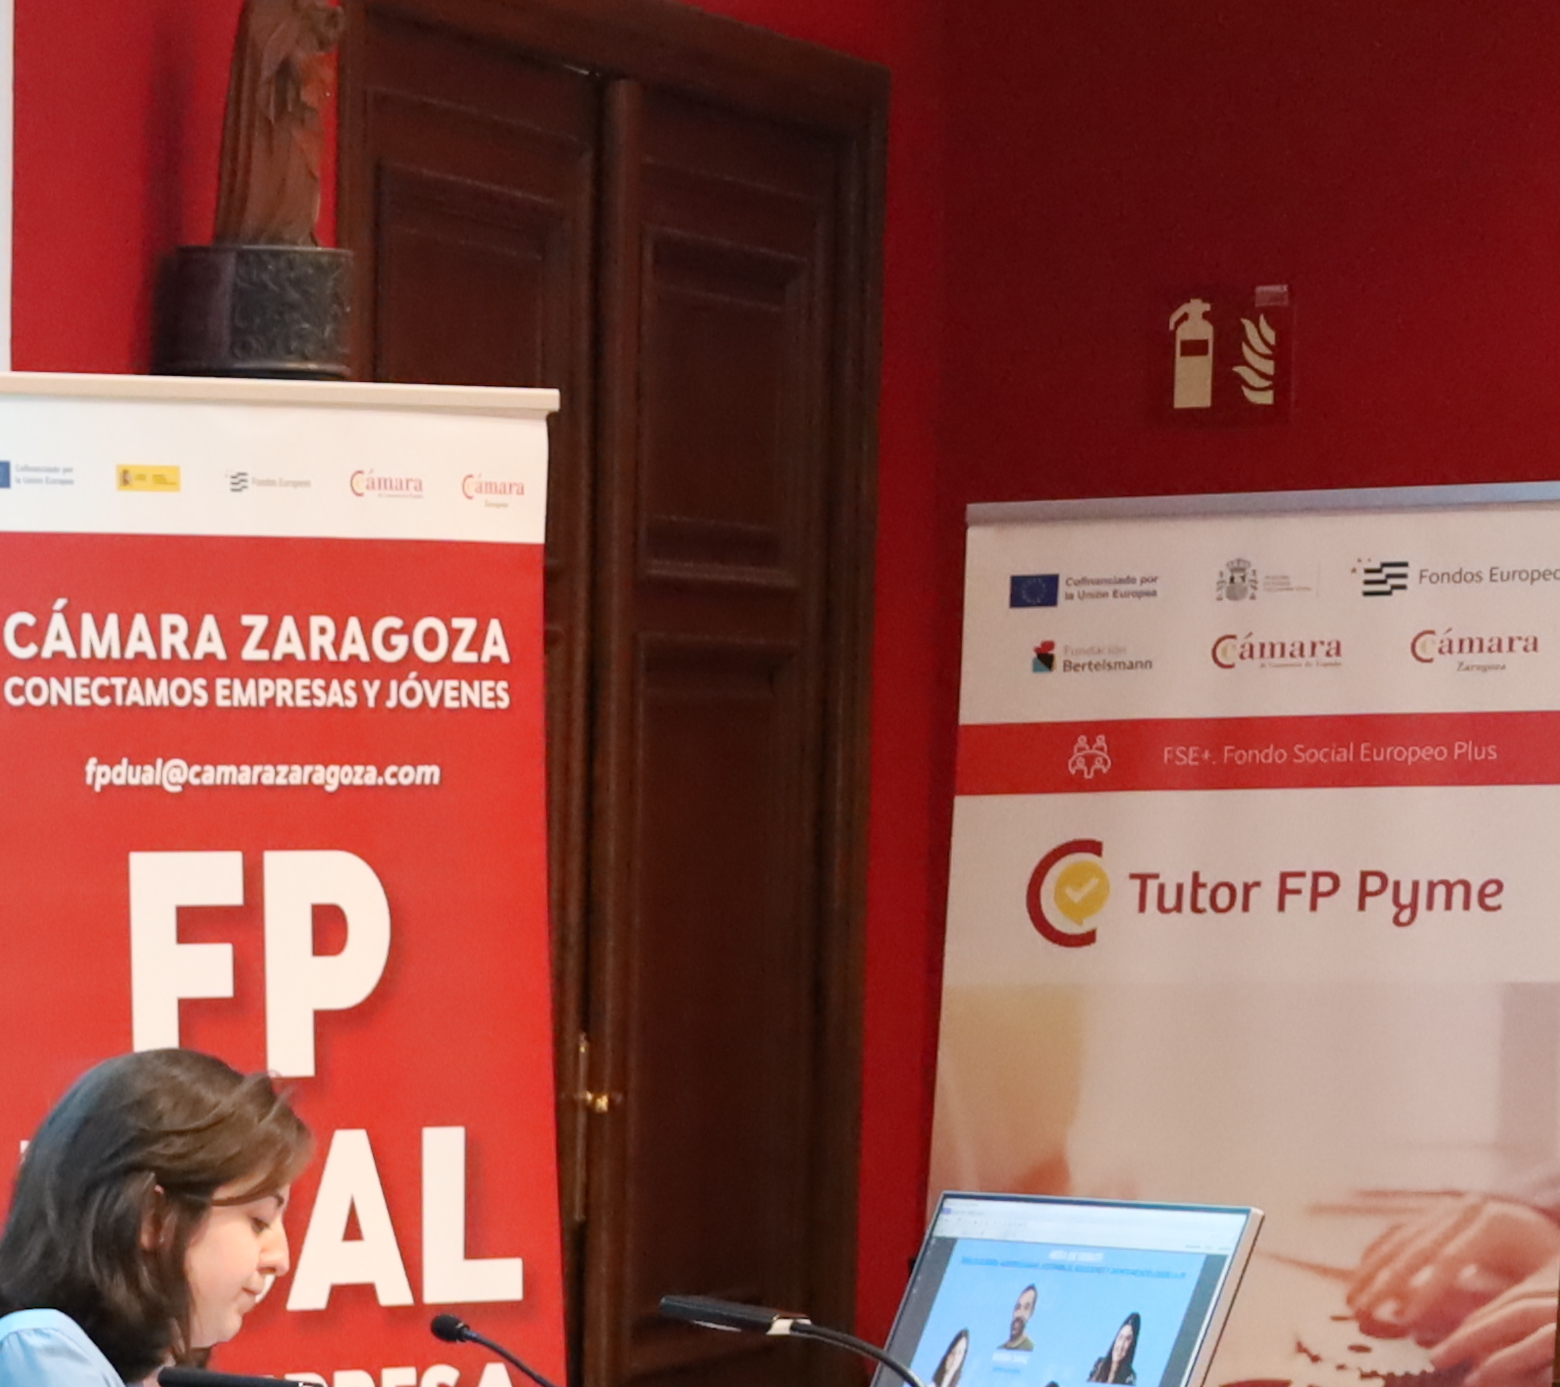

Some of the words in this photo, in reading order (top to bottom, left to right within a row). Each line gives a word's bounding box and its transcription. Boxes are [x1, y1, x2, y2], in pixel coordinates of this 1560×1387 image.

[350, 469, 424, 497] Cámara
[462, 473, 526, 501] Cámara
[1418, 567, 1484, 585] Fondos
[2, 597, 228, 661] CÁMARA
[240, 614, 511, 664] ZARAGOZA
[1410, 627, 1540, 663] Cámara
[1062, 658, 1153, 673] Bertelsmann
[1211, 632, 1343, 669] Cámara
[2, 676, 209, 708] CONECTAMOS
[215, 676, 358, 709] EMPRESAS
[362, 679, 383, 709] Y
[385, 671, 511, 710] JÓVENES
[1224, 744, 1288, 765] Fondo
[1293, 742, 1355, 764] Social
[1360, 741, 1448, 766] Europeo
[1454, 740, 1498, 762] Plus
[84, 757, 441, 793] fpdual@camarazaragoza.com
[1129, 870, 1262, 915] Tutor
[1276, 870, 1341, 913] FP
[1357, 869, 1505, 928] Pyme
[128, 849, 392, 1079] FP
